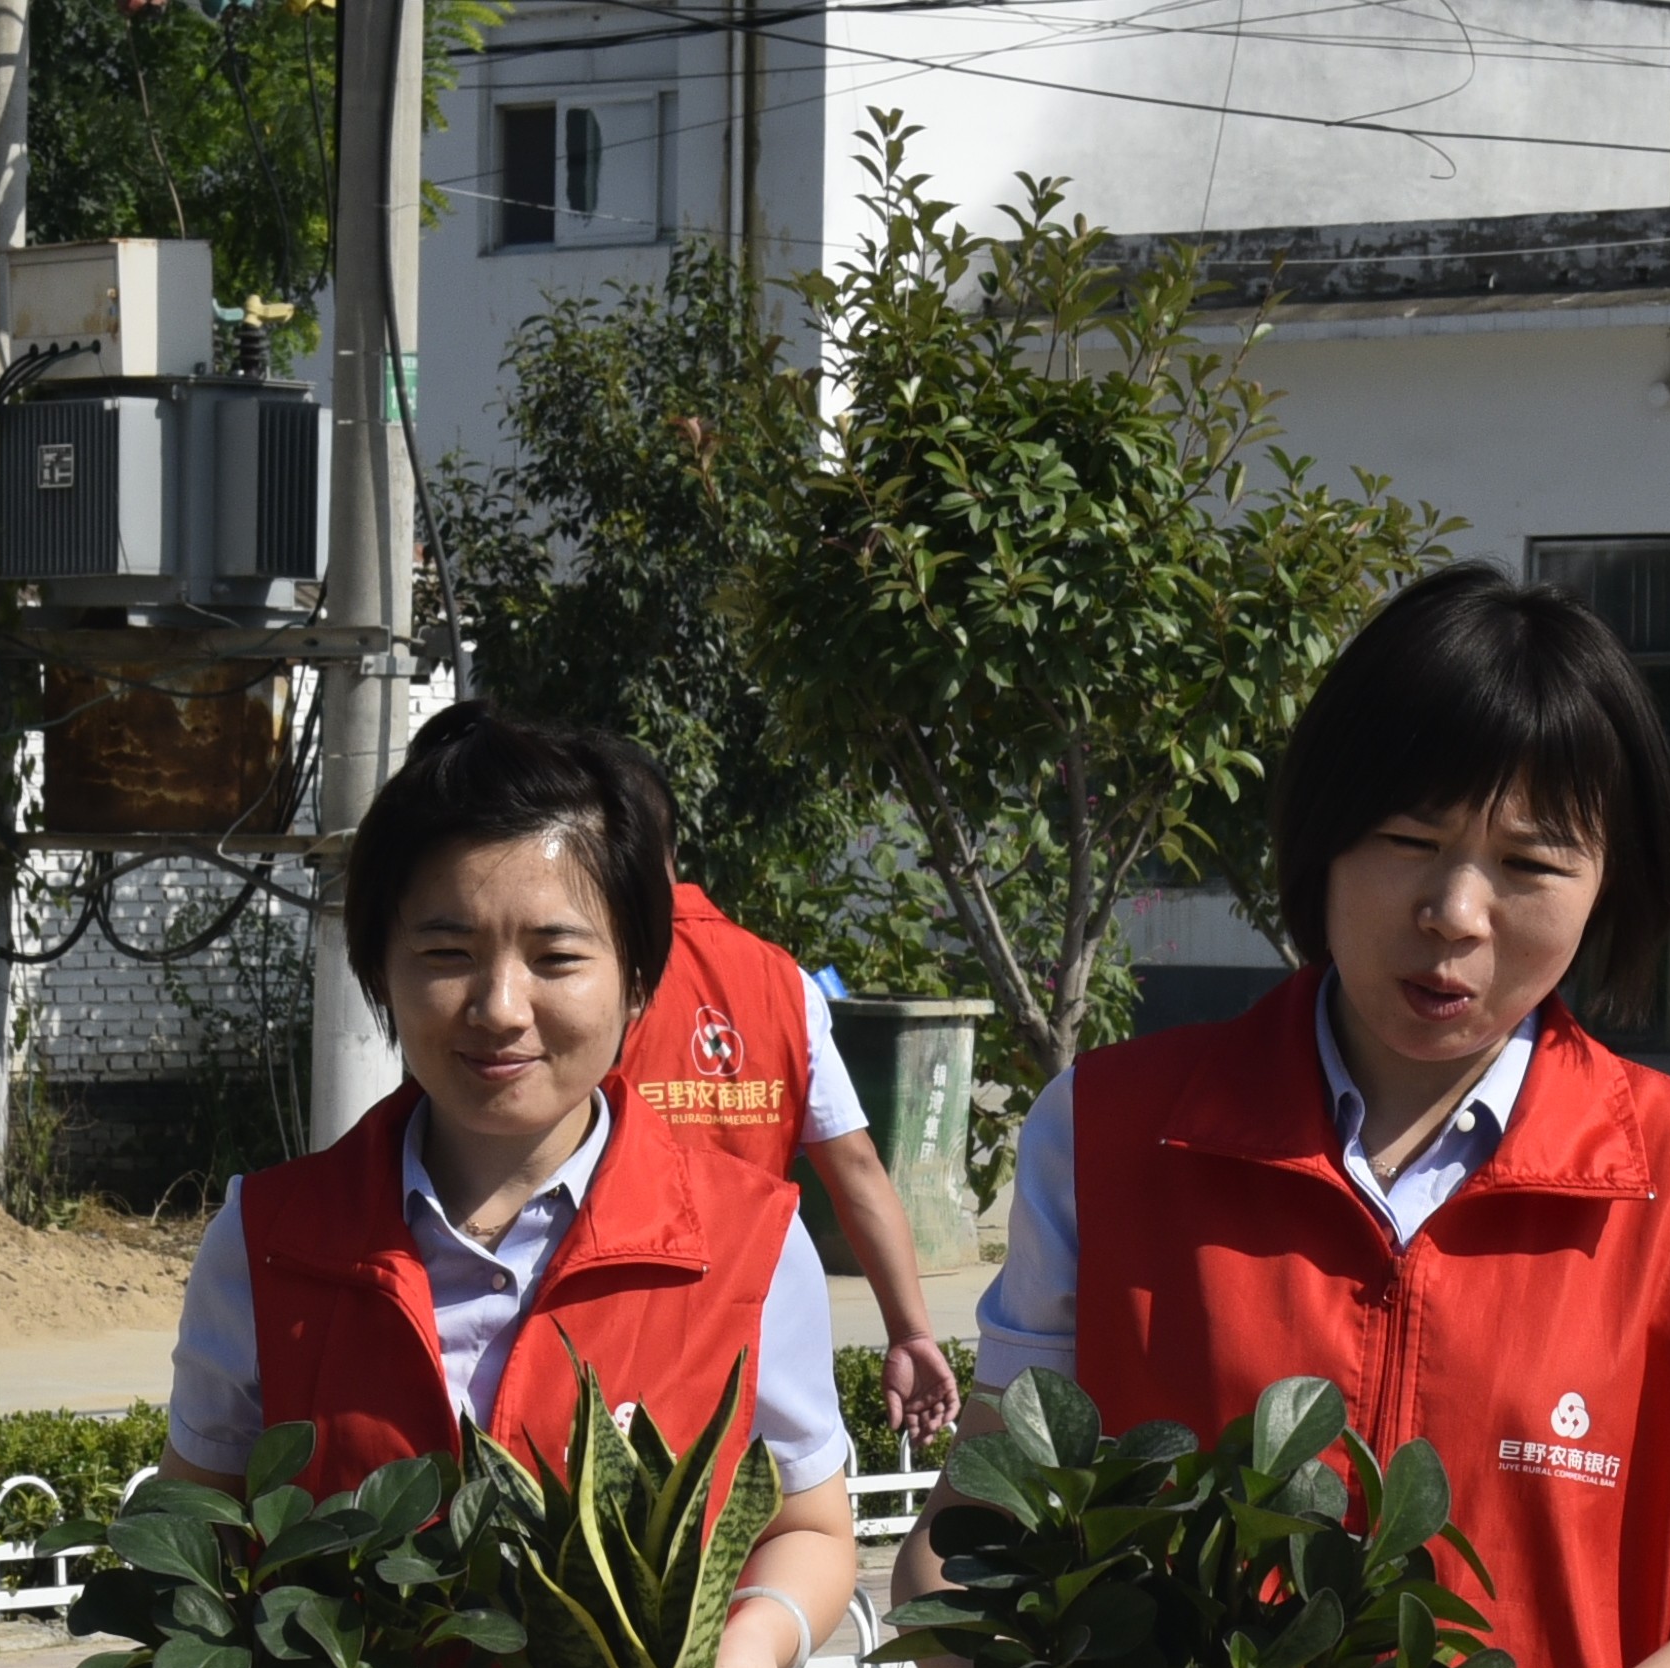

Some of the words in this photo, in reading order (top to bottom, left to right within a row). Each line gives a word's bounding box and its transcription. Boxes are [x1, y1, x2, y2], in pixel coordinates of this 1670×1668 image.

[638, 1079, 785, 1110] 巨野农商银行
[1497, 1462, 1521, 1472] JUYE
[1522, 1464, 1552, 1476] RURAL
[1553, 1469, 1599, 1486] COMMERCIAL
[1498, 1439, 1621, 1478] 巨野农商银行
